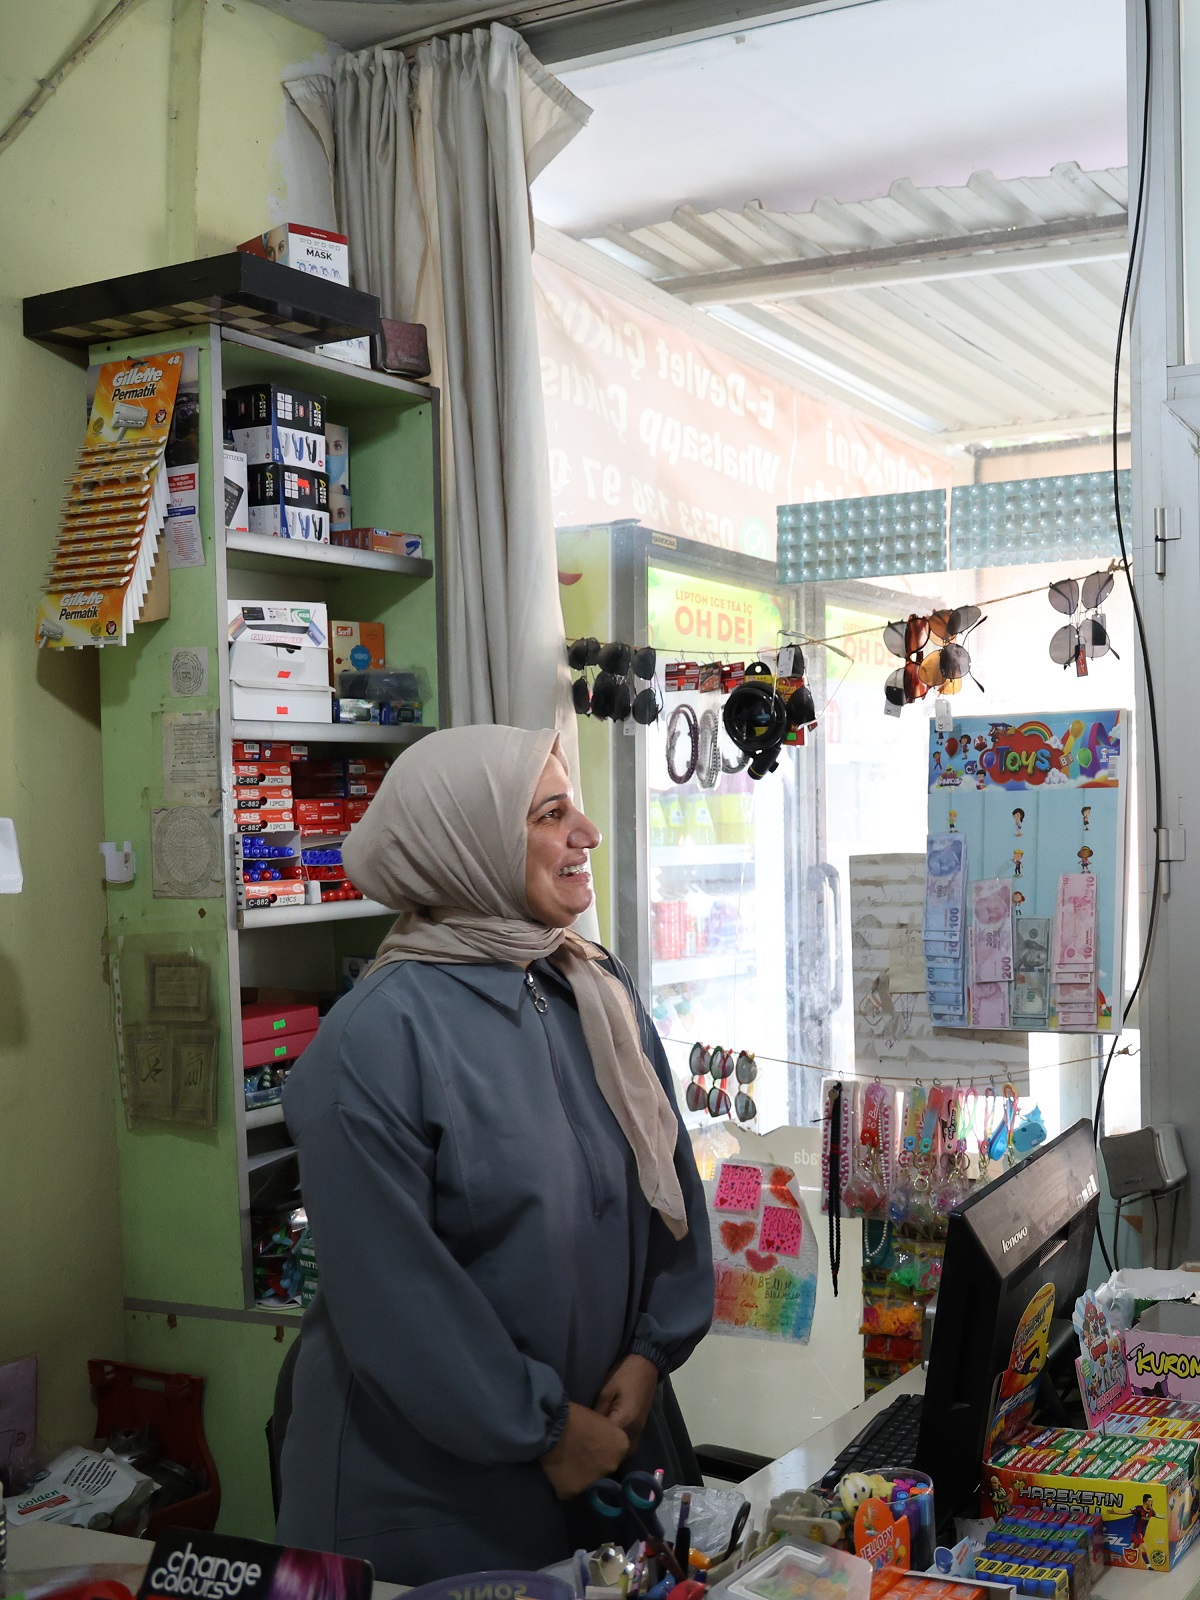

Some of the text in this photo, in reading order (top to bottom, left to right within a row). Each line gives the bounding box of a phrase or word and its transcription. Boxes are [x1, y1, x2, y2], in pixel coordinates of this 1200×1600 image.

[306, 248, 333, 261] MASK
[167, 356, 180, 365] 48
[112, 367, 163, 387] Gillette
[112, 383, 157, 401] Permatik
[61, 591, 104, 607] Gillette
[675, 589, 708, 605] LIPTON
[710, 595, 725, 608] ICE
[727, 598, 742, 612] TEA
[59, 606, 99, 620] Permatik
[675, 605, 753, 646] OH DE!
[950, 908, 959, 928] 100
[1002, 956, 1012, 980] 200
[1001, 1225, 1028, 1254] lenovo
[17, 1488, 60, 1510] Golden
[1019, 1486, 1123, 1508] HAREKETİN
[168, 1542, 262, 1595] change
[151, 1567, 230, 1599] colours
